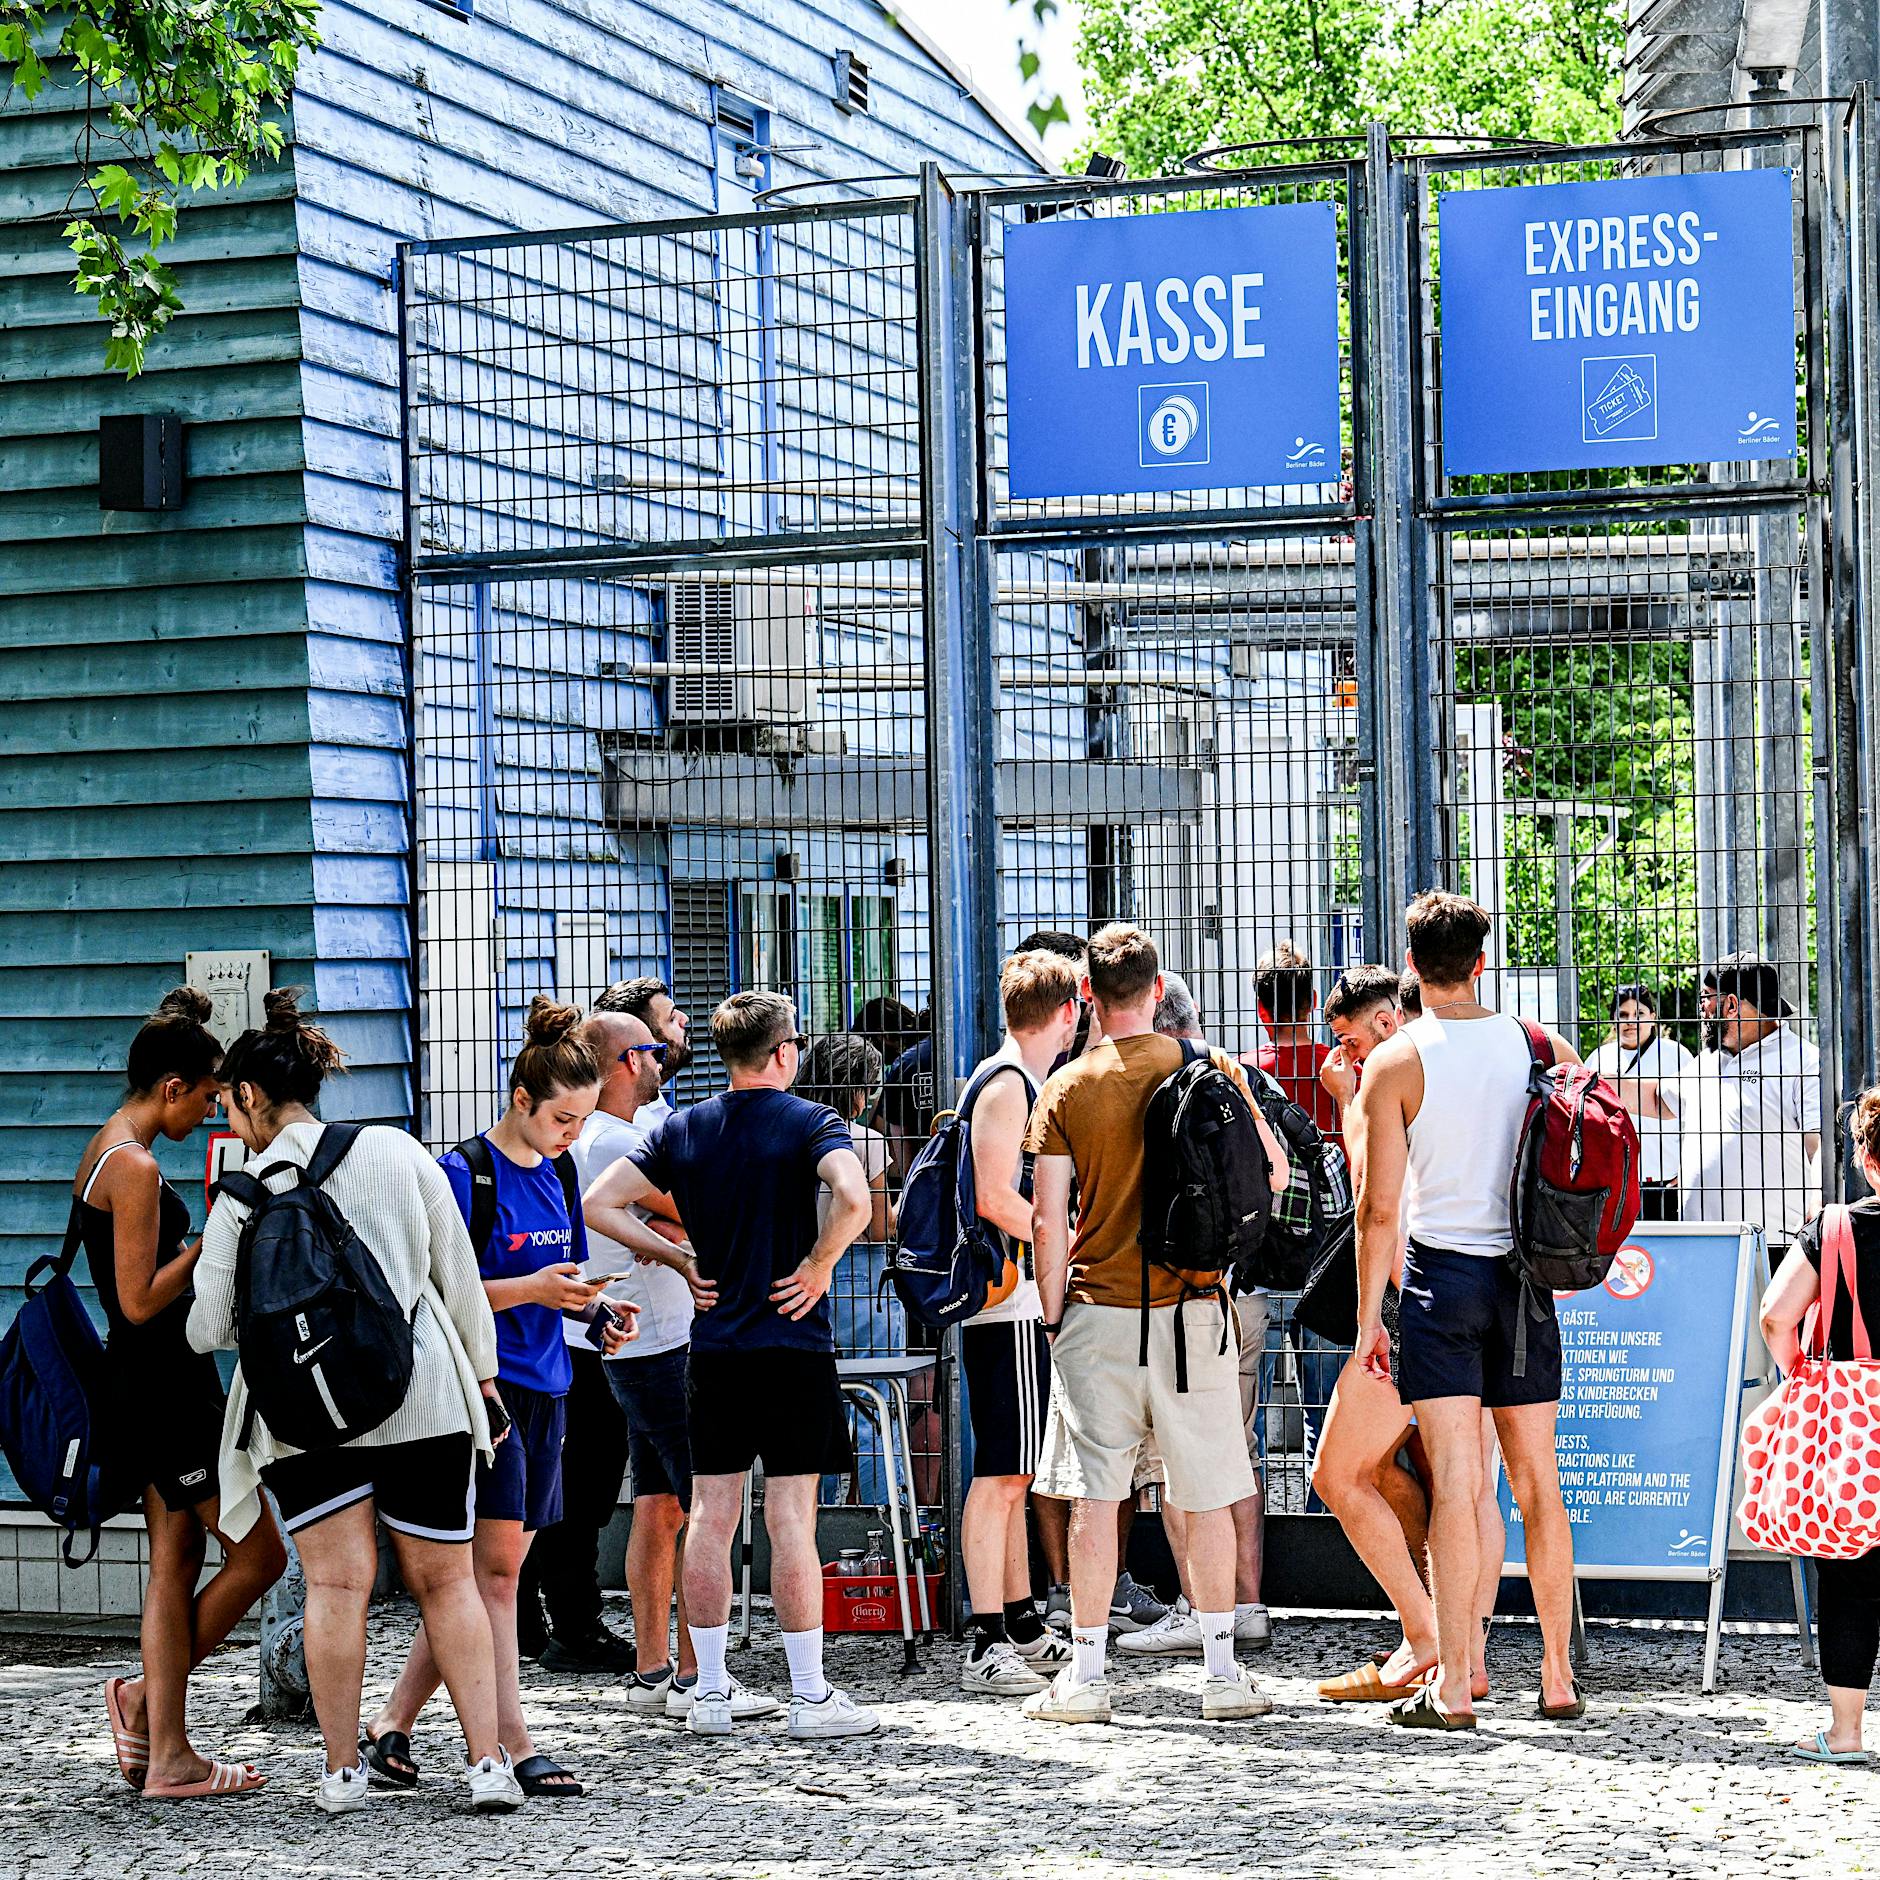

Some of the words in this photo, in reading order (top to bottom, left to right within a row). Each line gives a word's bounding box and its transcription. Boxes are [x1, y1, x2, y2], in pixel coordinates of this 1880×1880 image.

[1525, 211, 1718, 276] EXPRESS-
[1530, 277, 1700, 341] EINGANG
[1075, 272, 1266, 369] KASSE
[1598, 392, 1626, 415] TICKET
[1762, 435, 1780, 443] Bäder
[530, 1228, 571, 1246] YOKOHA
[938, 1300, 962, 1315] adidas
[1563, 1309, 1599, 1327] GÄSTE,
[1577, 1330, 1619, 1346] STEHEN
[1620, 1331, 1663, 1346] UNSERE
[1561, 1349, 1606, 1364] KTIONEN
[1608, 1349, 1629, 1364] WIE
[1561, 1367, 1575, 1383] HE,
[1577, 1367, 1649, 1382] SPRUNGTURM
[1651, 1368, 1675, 1383] UND
[1560, 1385, 1575, 1400] AS
[1577, 1386, 1659, 1401] KINDERBECKEN
[1578, 1402, 1643, 1419] VERFÜGUNG.
[1554, 1434, 1590, 1450] UESTS,
[1611, 1453, 1636, 1469] LIKE
[1558, 1471, 1585, 1487] VING
[1586, 1472, 1642, 1487] PLATFORM
[1643, 1473, 1667, 1488] AND
[1669, 1473, 1691, 1488] THE
[1575, 1490, 1603, 1505] POOL
[1604, 1491, 1626, 1505] ARE
[1628, 1491, 1691, 1507] CURRENTLY
[855, 1605, 883, 1619] Harry
[1215, 1630, 1234, 1641] elles
